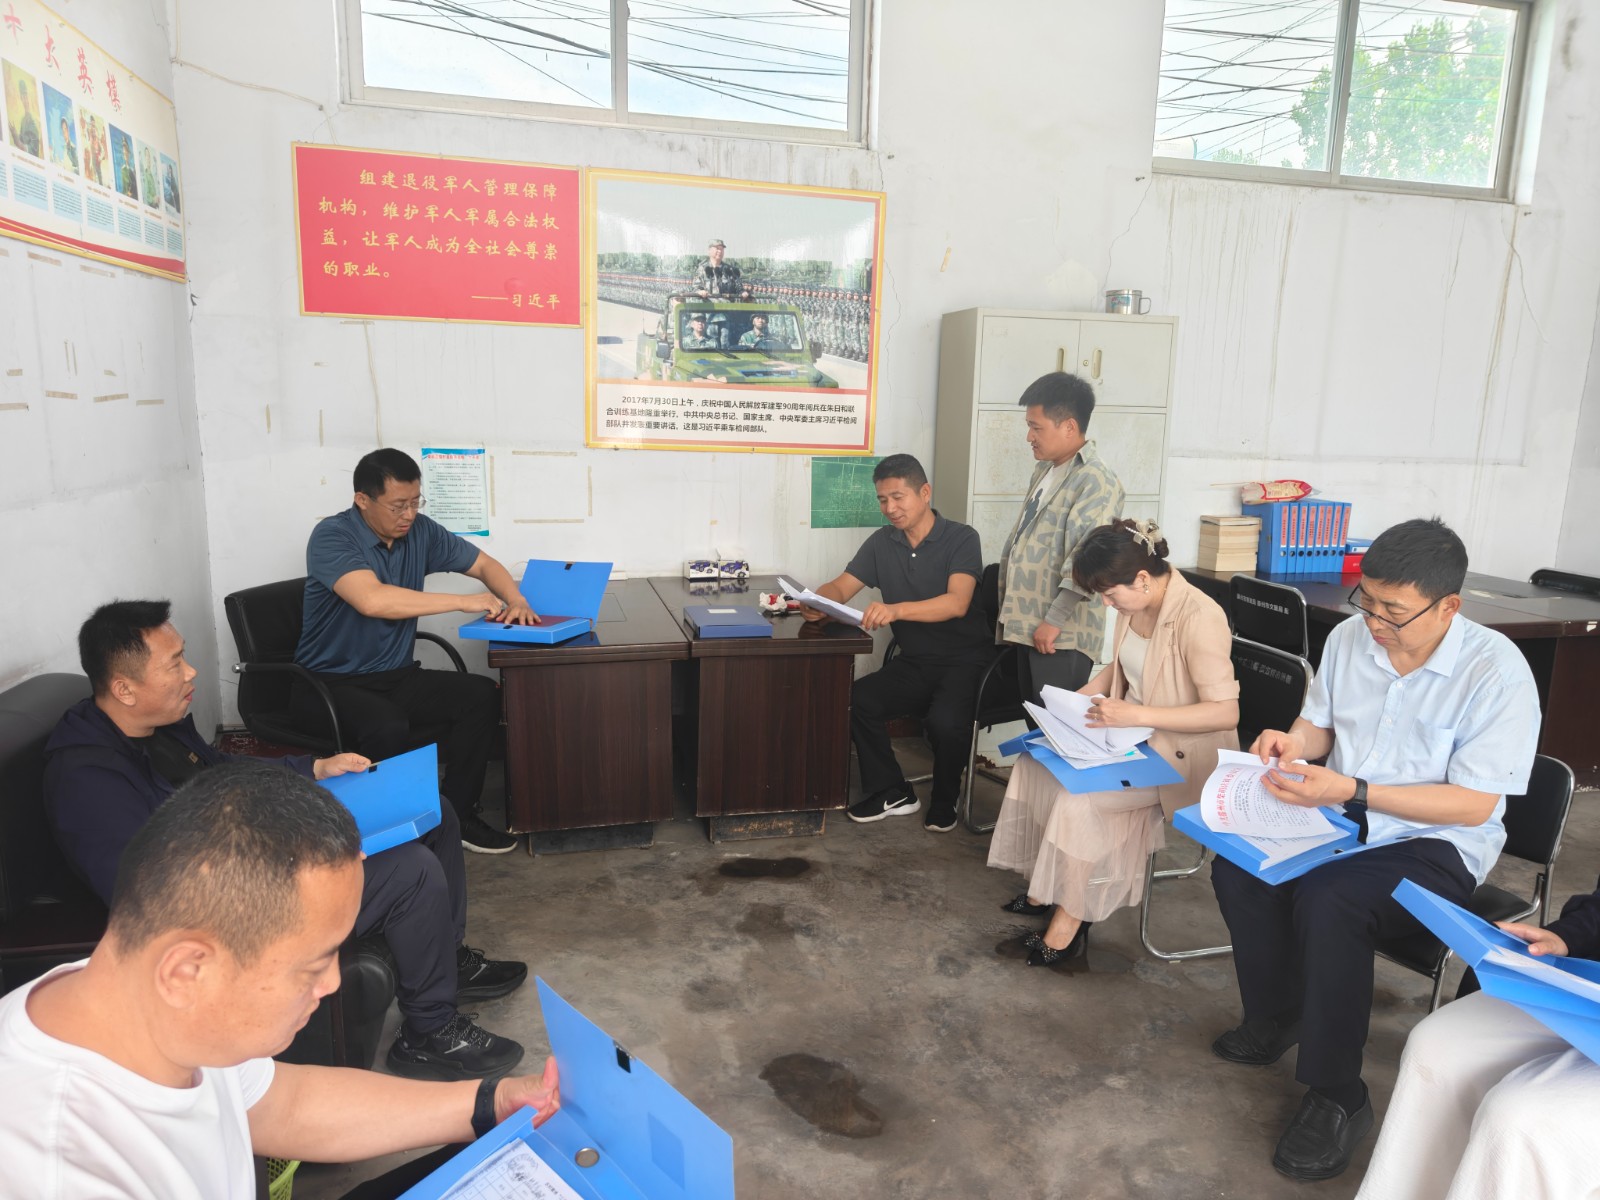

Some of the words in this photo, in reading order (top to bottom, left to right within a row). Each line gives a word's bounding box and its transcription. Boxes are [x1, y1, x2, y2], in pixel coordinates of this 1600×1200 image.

[359, 168, 558, 202] 组建退役军人管理保障
[318, 196, 560, 231] 机构，维护军人军属合法权
[321, 228, 559, 261] 益，让军人成为全社会尊崇
[323, 260, 391, 278] 的职业。
